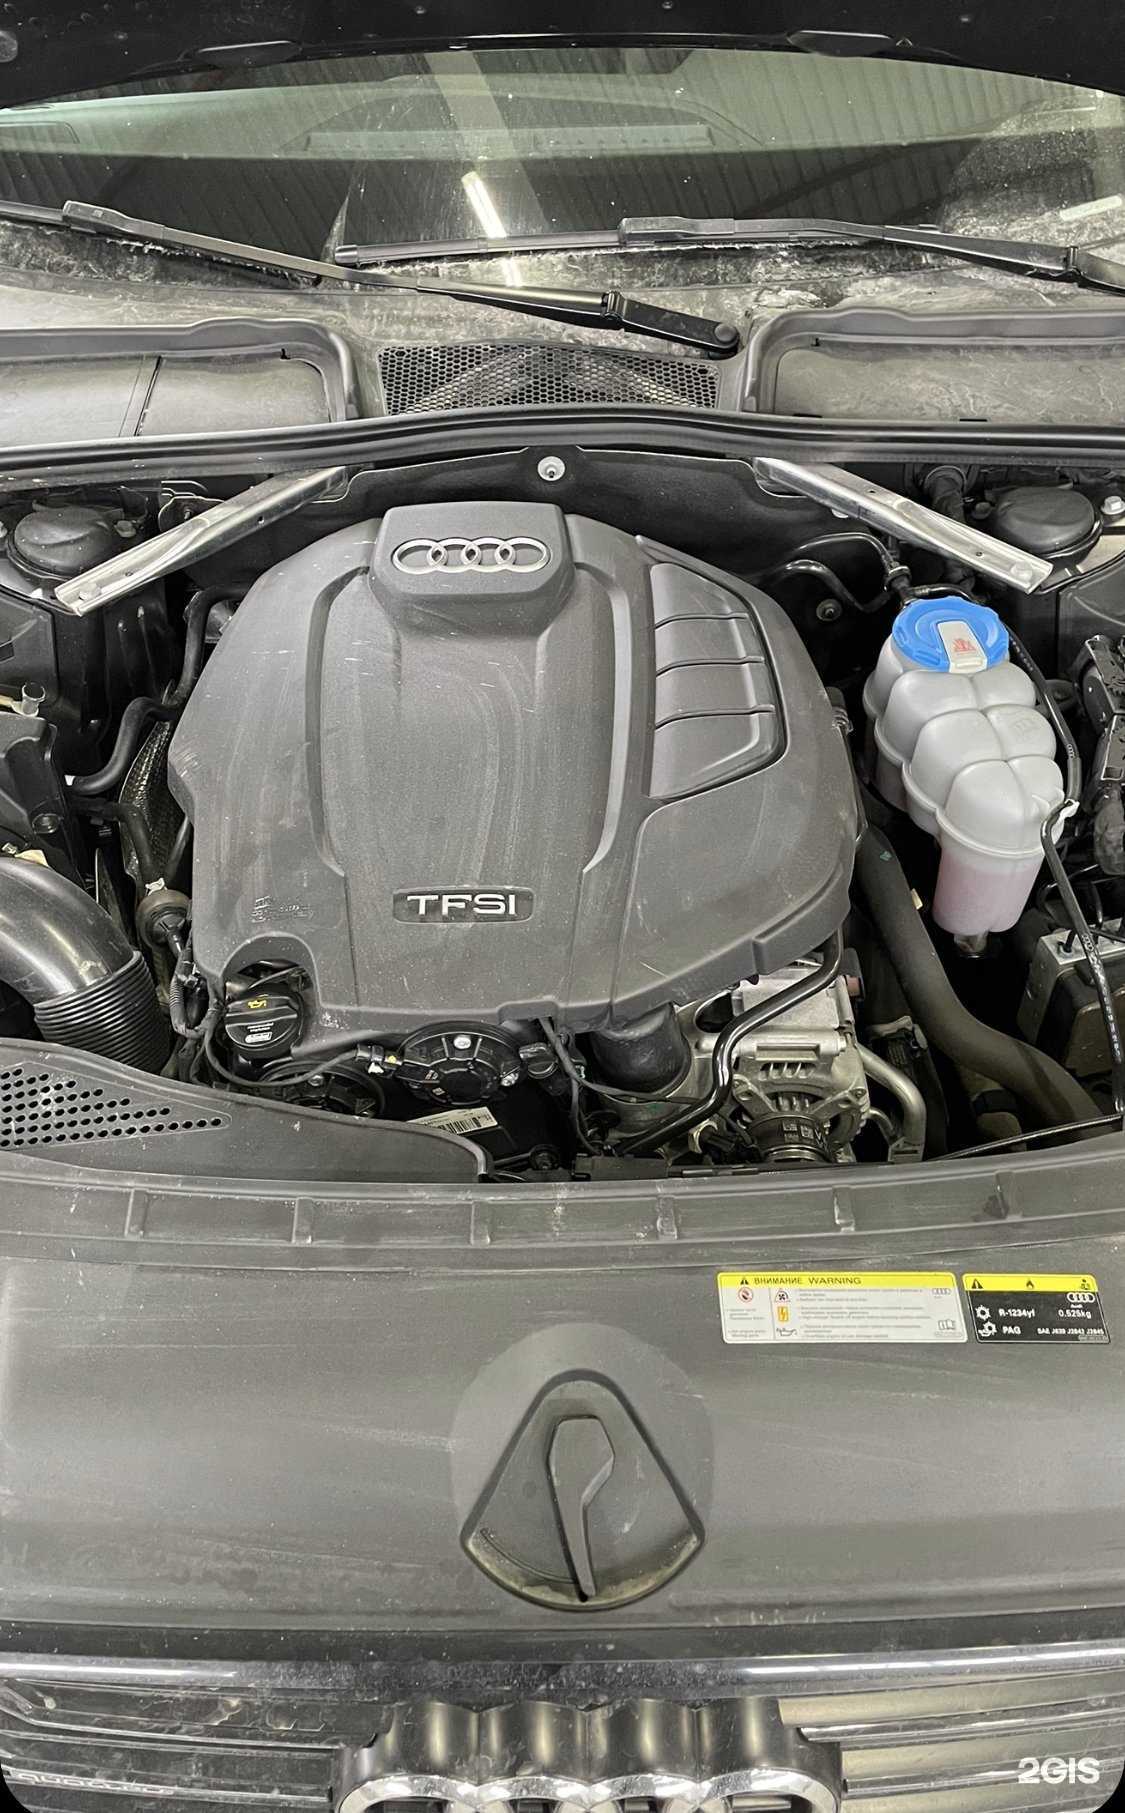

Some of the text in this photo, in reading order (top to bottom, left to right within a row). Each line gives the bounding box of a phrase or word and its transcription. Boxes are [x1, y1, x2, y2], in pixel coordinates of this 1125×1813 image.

[406, 893, 517, 916] TFSI
[754, 1276, 862, 1285] ВНИМАНИЕ WARNING
[998, 1308, 1036, 1319] R-1234yf
[1058, 1309, 1092, 1320] 0.525kg
[1002, 1325, 1021, 1335] PAG
